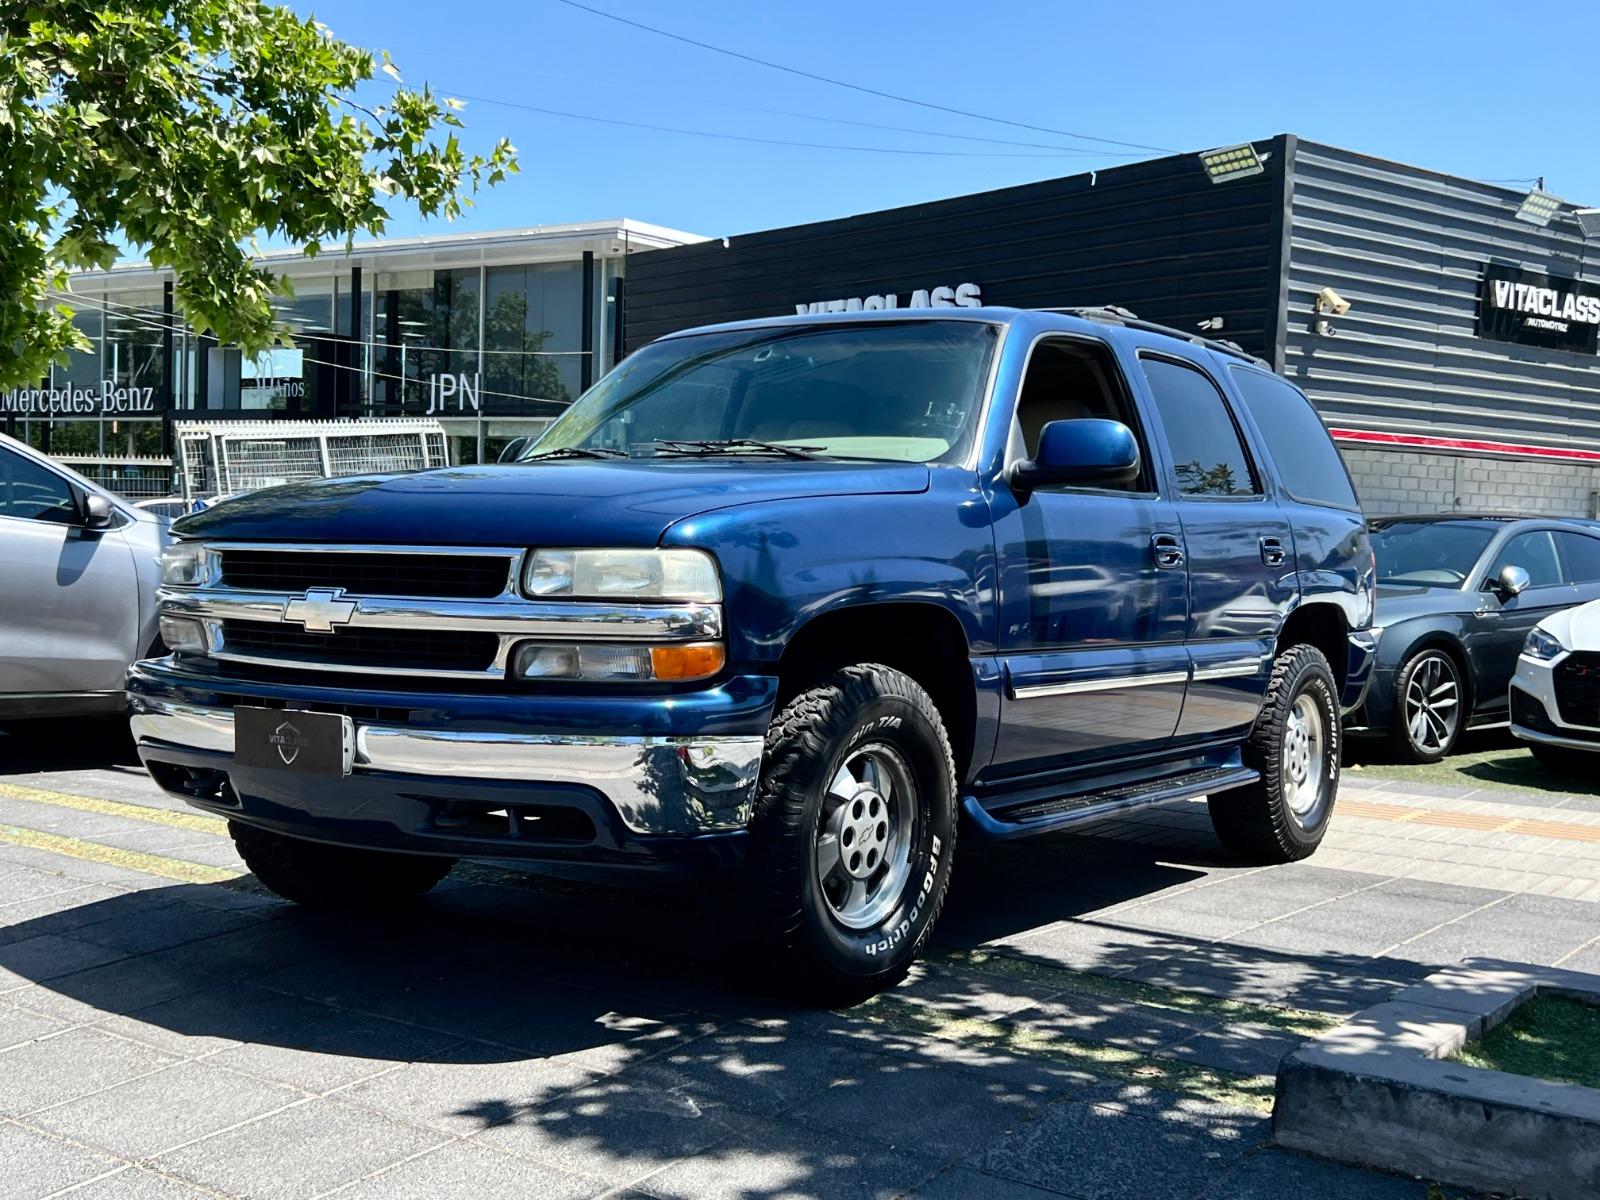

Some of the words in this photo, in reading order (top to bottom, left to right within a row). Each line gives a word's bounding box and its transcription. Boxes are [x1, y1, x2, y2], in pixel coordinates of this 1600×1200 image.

[1491, 280, 1600, 324] VITACLASS
[1525, 317, 1569, 333] AUTOMOTRIZ
[1, 380, 154, 413] Mercedes-Benz
[273, 378, 305, 398] Años
[425, 372, 481, 415] JPN
[877, 715, 903, 729] T/A
[1315, 678, 1338, 749] All-Terrain
[1329, 753, 1338, 780] T/A
[865, 834, 941, 957] BFGoodrich
